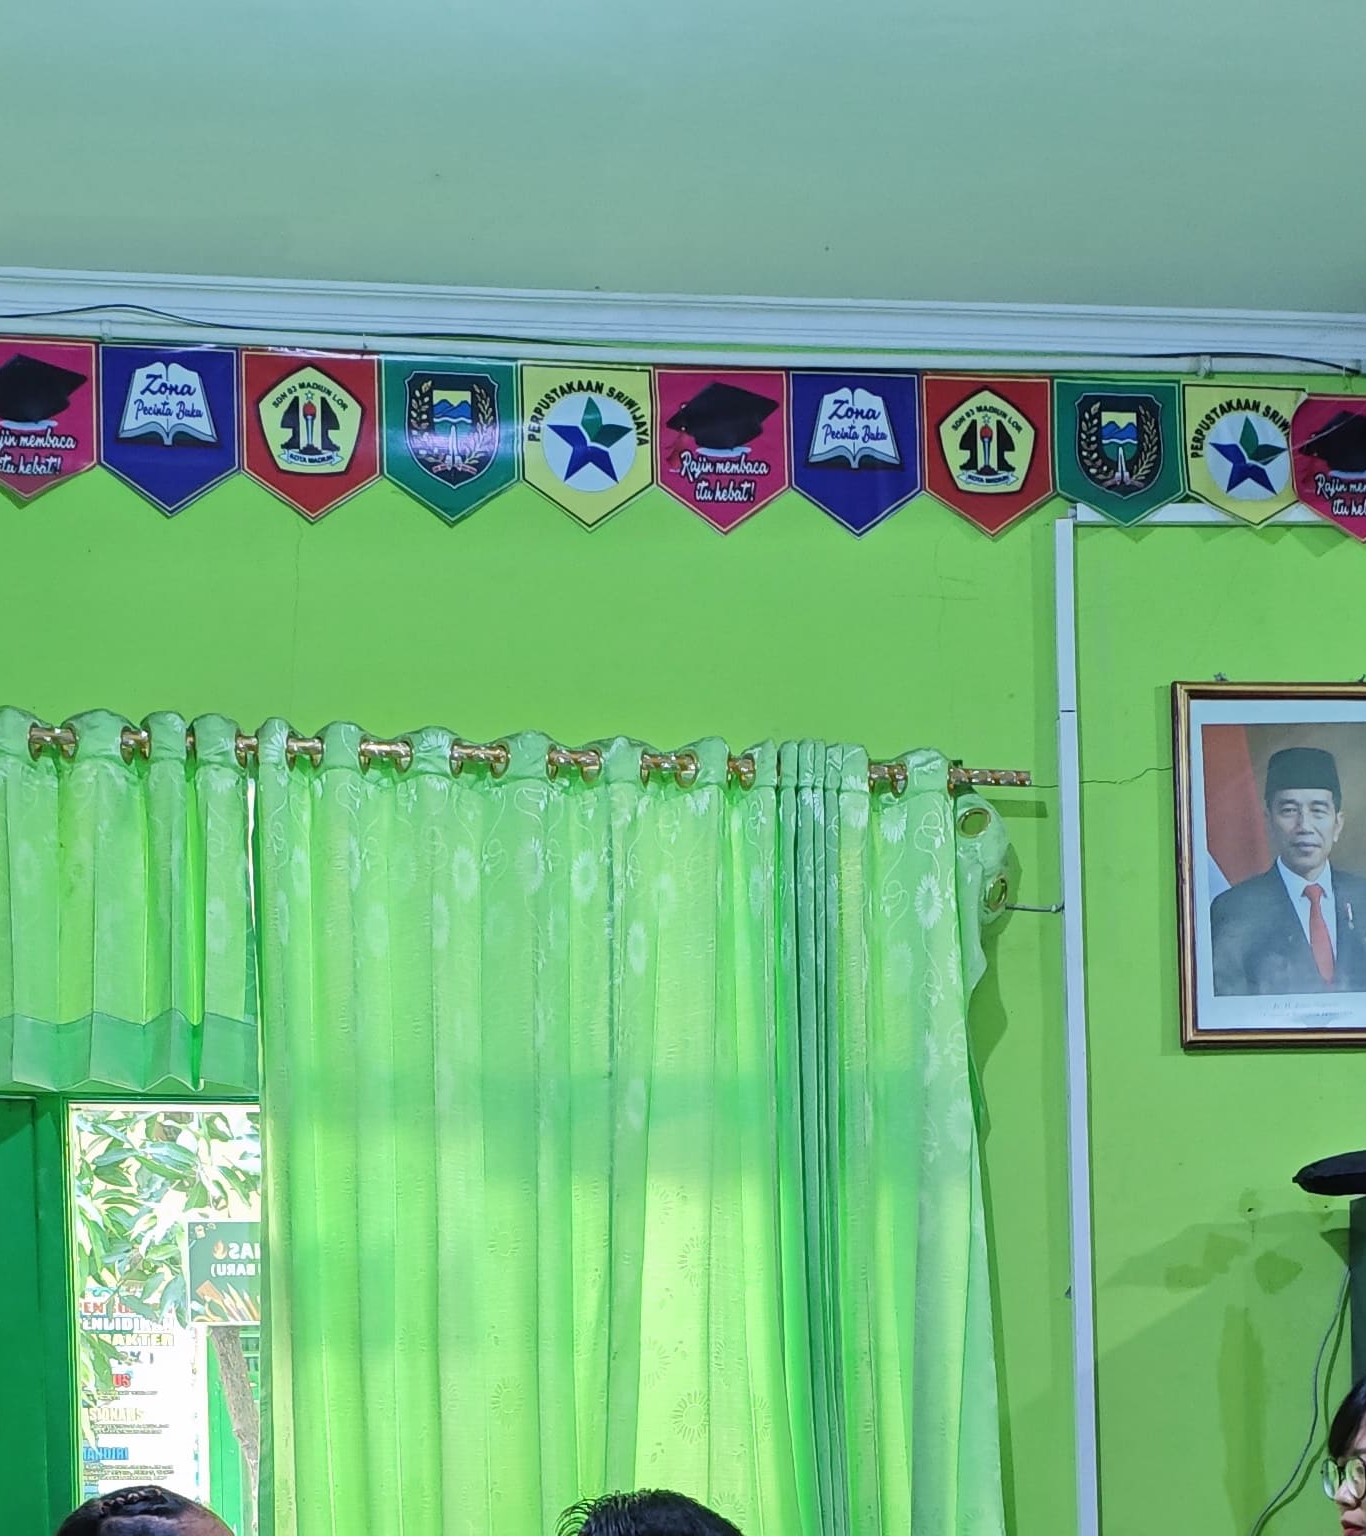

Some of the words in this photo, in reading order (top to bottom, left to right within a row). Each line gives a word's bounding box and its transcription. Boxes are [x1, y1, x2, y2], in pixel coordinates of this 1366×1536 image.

[140, 373, 196, 396] Zona
[298, 381, 332, 397] MADIUN
[332, 394, 348, 411] LOR
[134, 400, 173, 420] Pecinta
[176, 401, 203, 419] Buku
[527, 379, 605, 443] PERPUSTAKAAN
[606, 385, 650, 447] SRIWIJAYA
[828, 399, 880, 420] Zona
[822, 424, 859, 445] Pecinta
[862, 425, 888, 443] Buku
[1190, 398, 1261, 459] PERPUSTAKAAN
[19, 432, 77, 449] membaca
[18, 455, 62, 475] hebat!
[680, 452, 713, 478] Rajin
[715, 458, 770, 476] membaca
[695, 483, 713, 501] itu
[714, 482, 755, 503] hebat!
[1315, 474, 1347, 497] Rajin
[1333, 499, 1349, 516] itu
